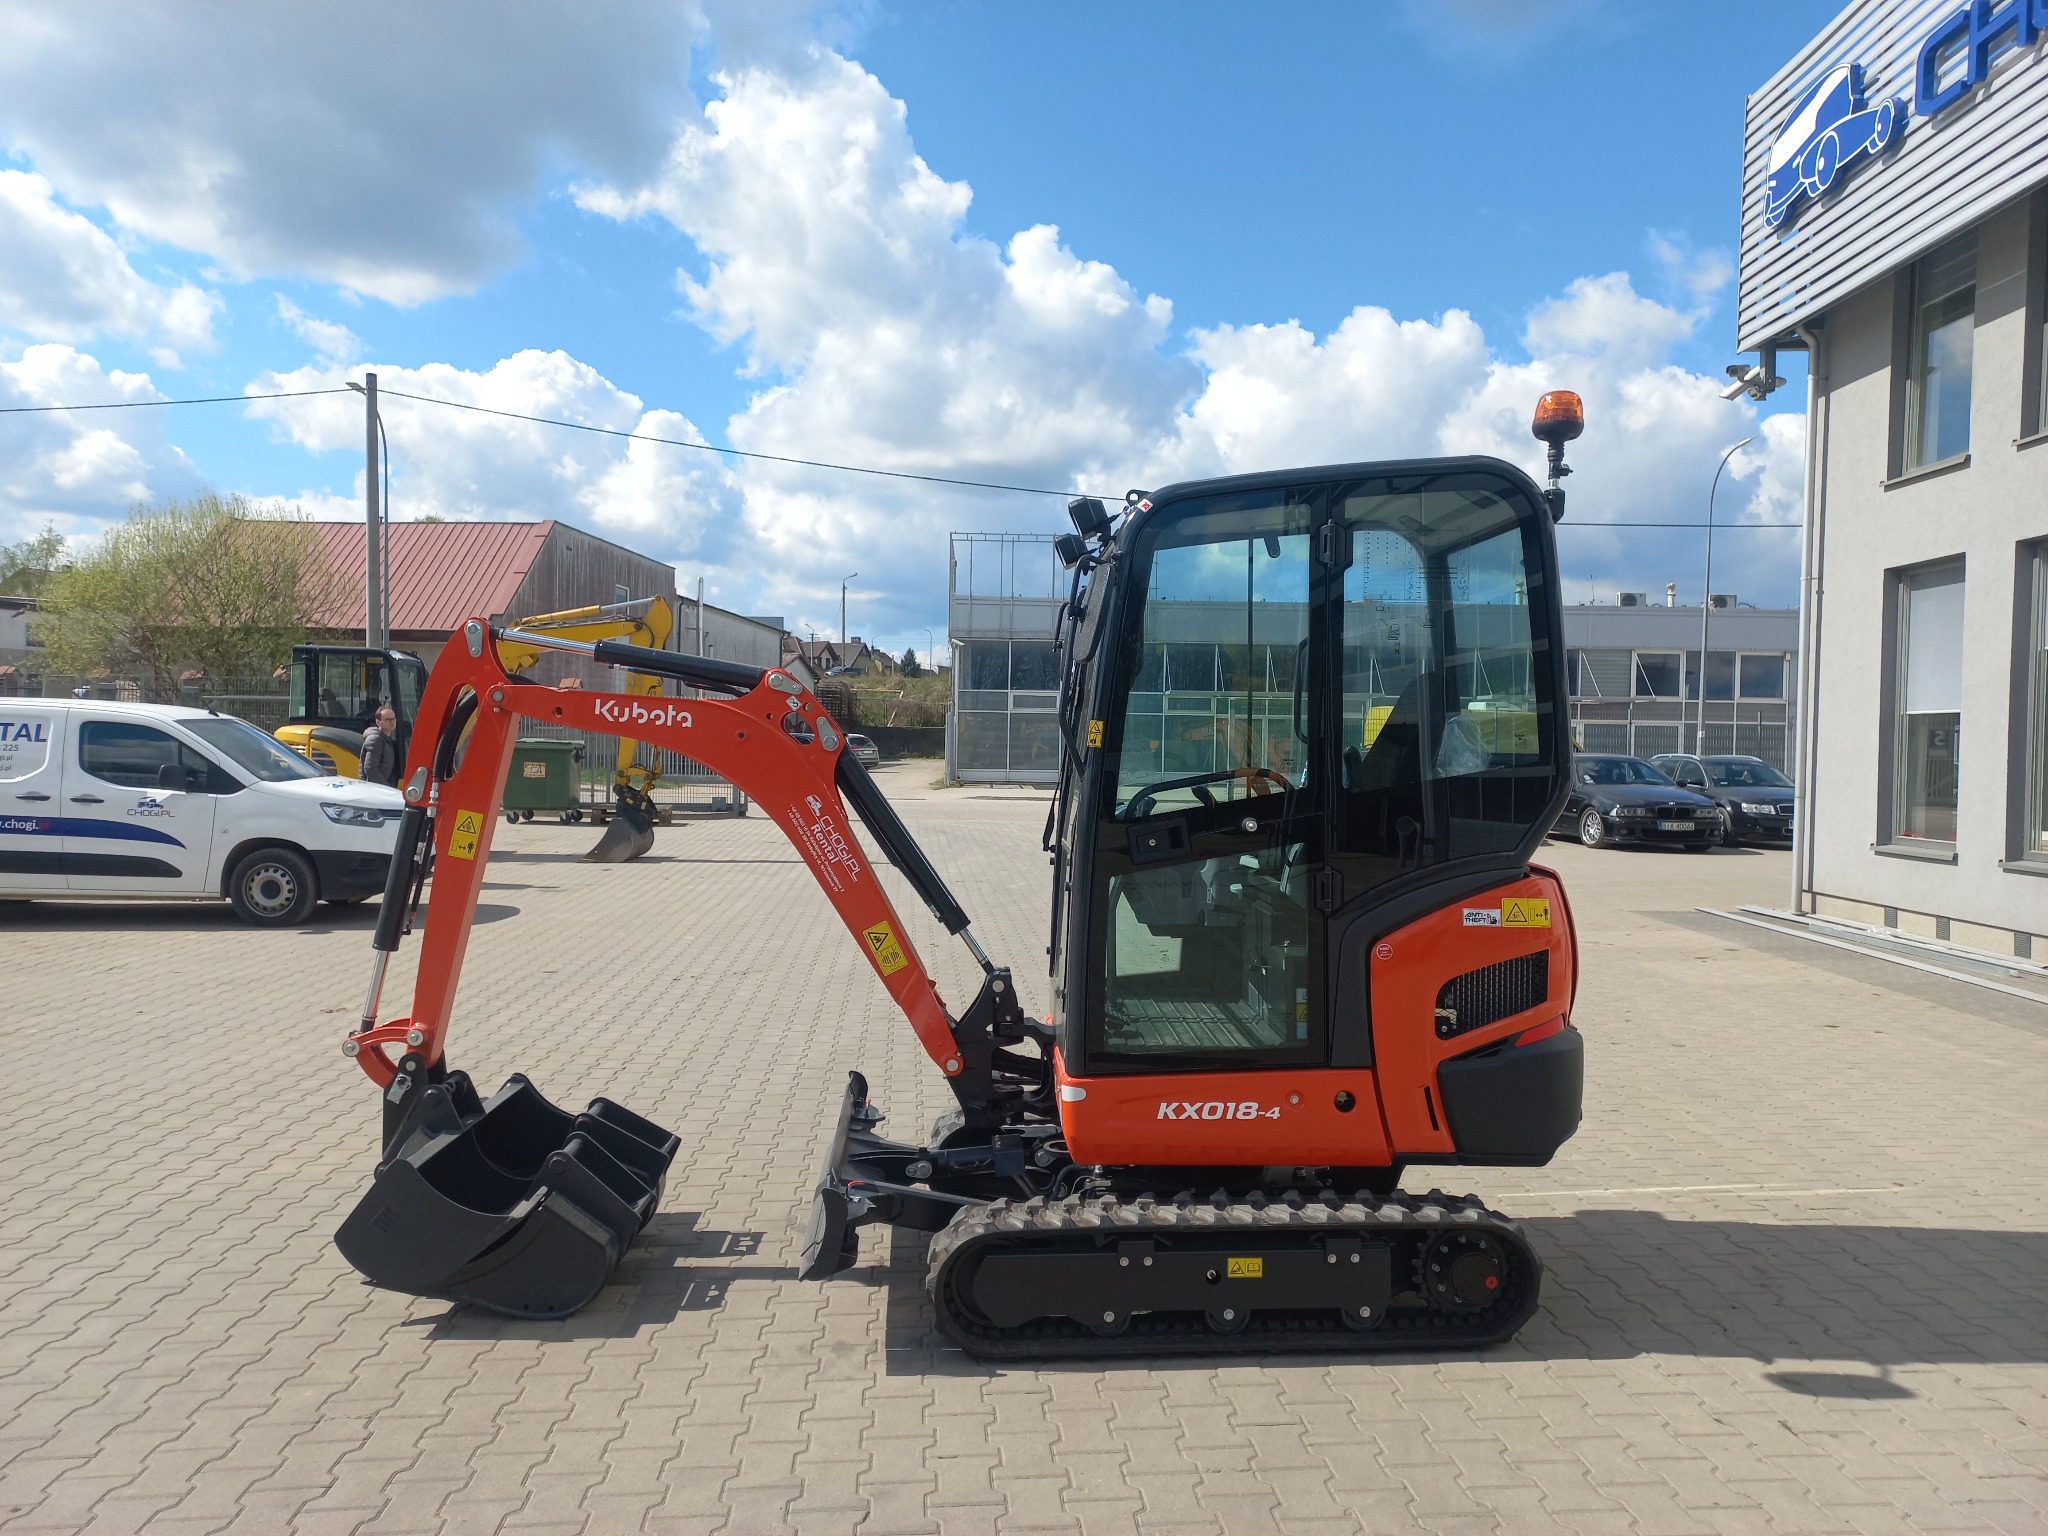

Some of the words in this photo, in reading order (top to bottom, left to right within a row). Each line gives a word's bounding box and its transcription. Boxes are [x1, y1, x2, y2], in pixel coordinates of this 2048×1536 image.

[1914, 0, 2048, 116] CH
[595, 699, 692, 728] Kubota
[811, 823, 840, 863] Rental
[820, 815, 861, 882] CHOGI.PL
[1157, 1102, 1280, 1120] KX018-4
